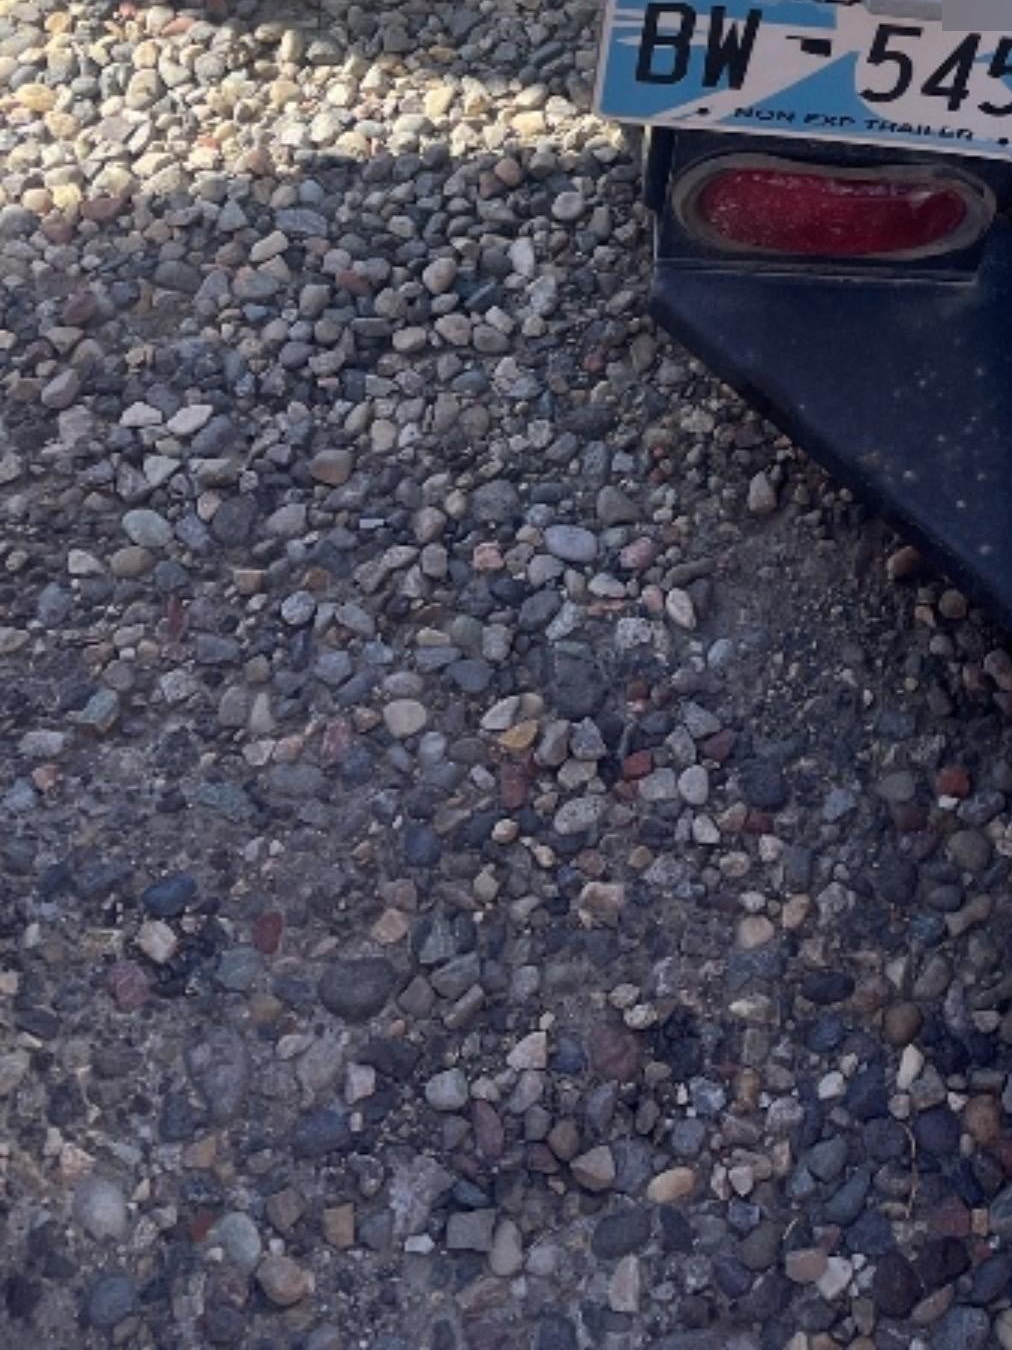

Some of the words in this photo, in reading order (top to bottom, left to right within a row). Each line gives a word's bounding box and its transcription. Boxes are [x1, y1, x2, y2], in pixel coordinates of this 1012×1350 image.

[732, 106, 796, 124] NON
[803, 112, 856, 128] EXP
[864, 118, 974, 141] TRAILER
